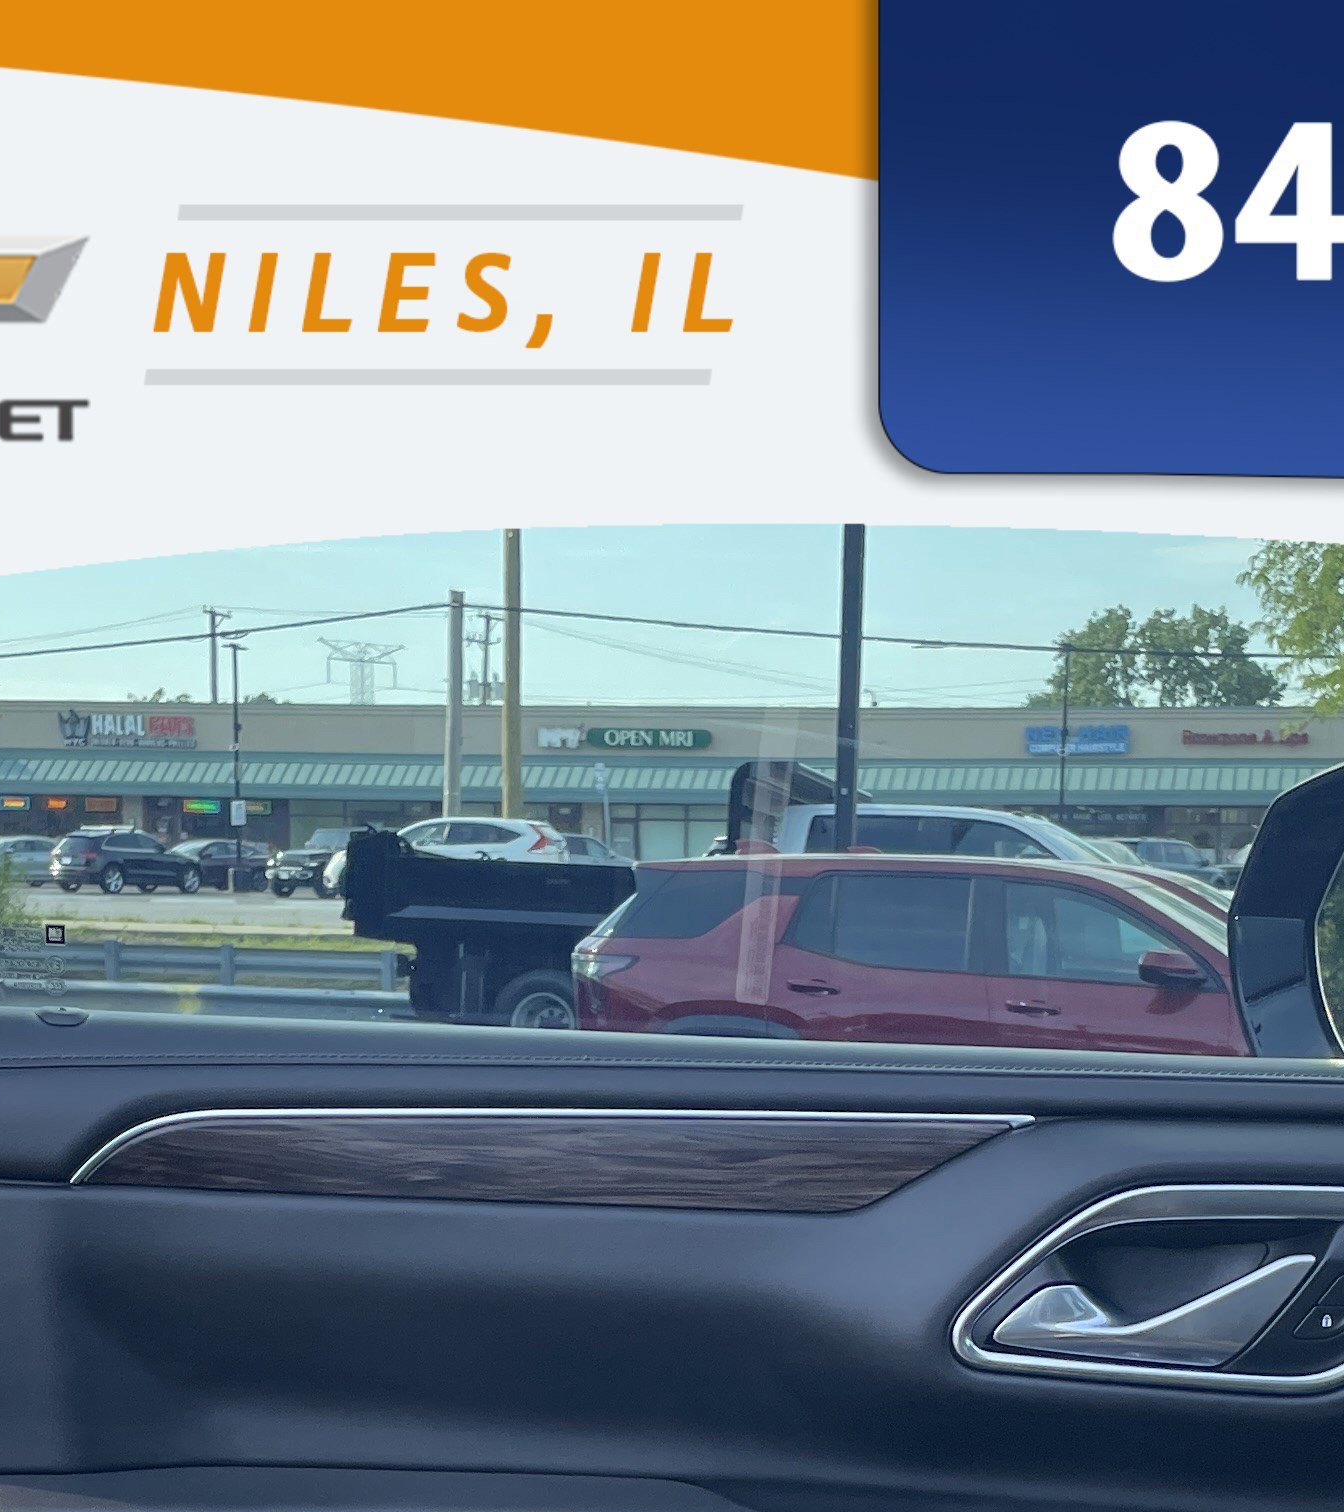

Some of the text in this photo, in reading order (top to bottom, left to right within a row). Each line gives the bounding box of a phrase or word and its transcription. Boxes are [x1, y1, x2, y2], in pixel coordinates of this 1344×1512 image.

[91, 714, 145, 736] HALAL
[604, 730, 653, 746] OPEN
[659, 731, 693, 747] MRI
